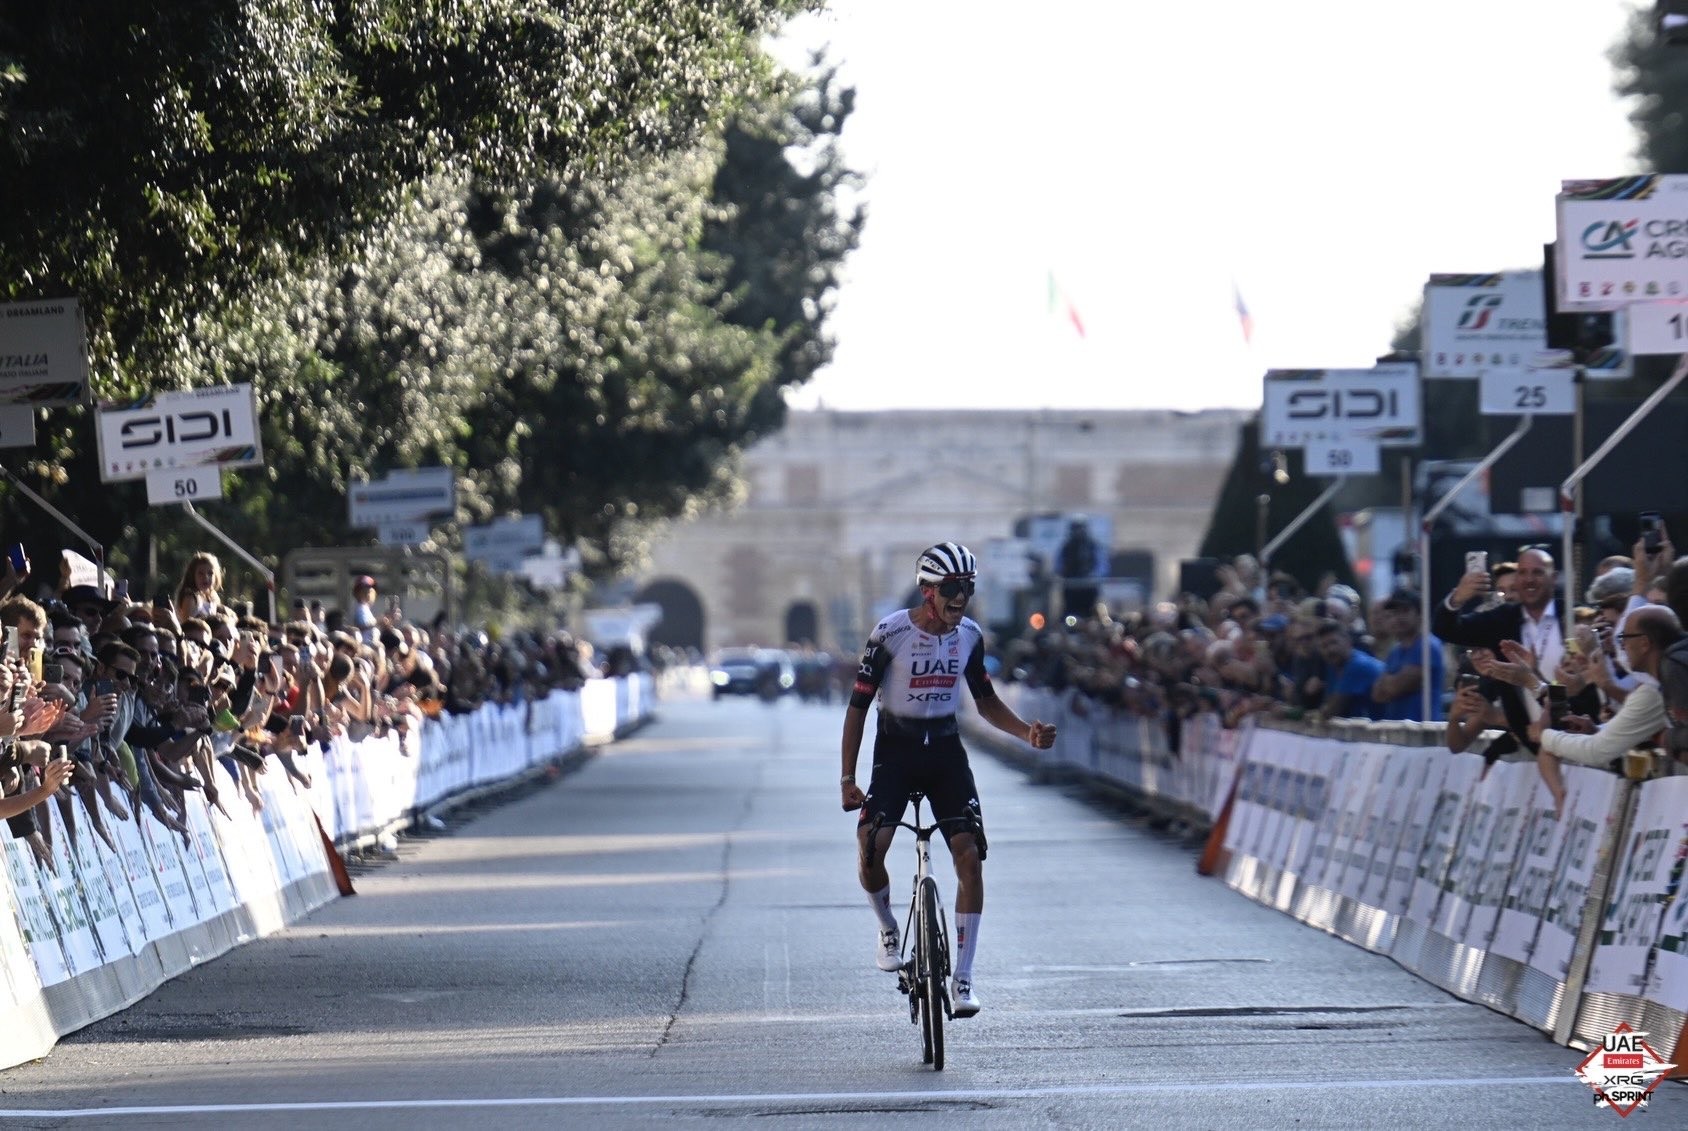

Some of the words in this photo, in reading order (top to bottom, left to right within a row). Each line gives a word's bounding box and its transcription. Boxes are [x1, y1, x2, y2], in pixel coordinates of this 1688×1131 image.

[7, 305, 65, 317] DREAMLAND
[1287, 389, 1399, 418] SIDI
[1514, 386, 1547, 408] 25
[121, 408, 232, 449] SIDI
[174, 478, 197, 497] 50
[911, 659, 959, 676] UAE
[915, 678, 954, 687] Emirates
[907, 692, 952, 702] XRG
